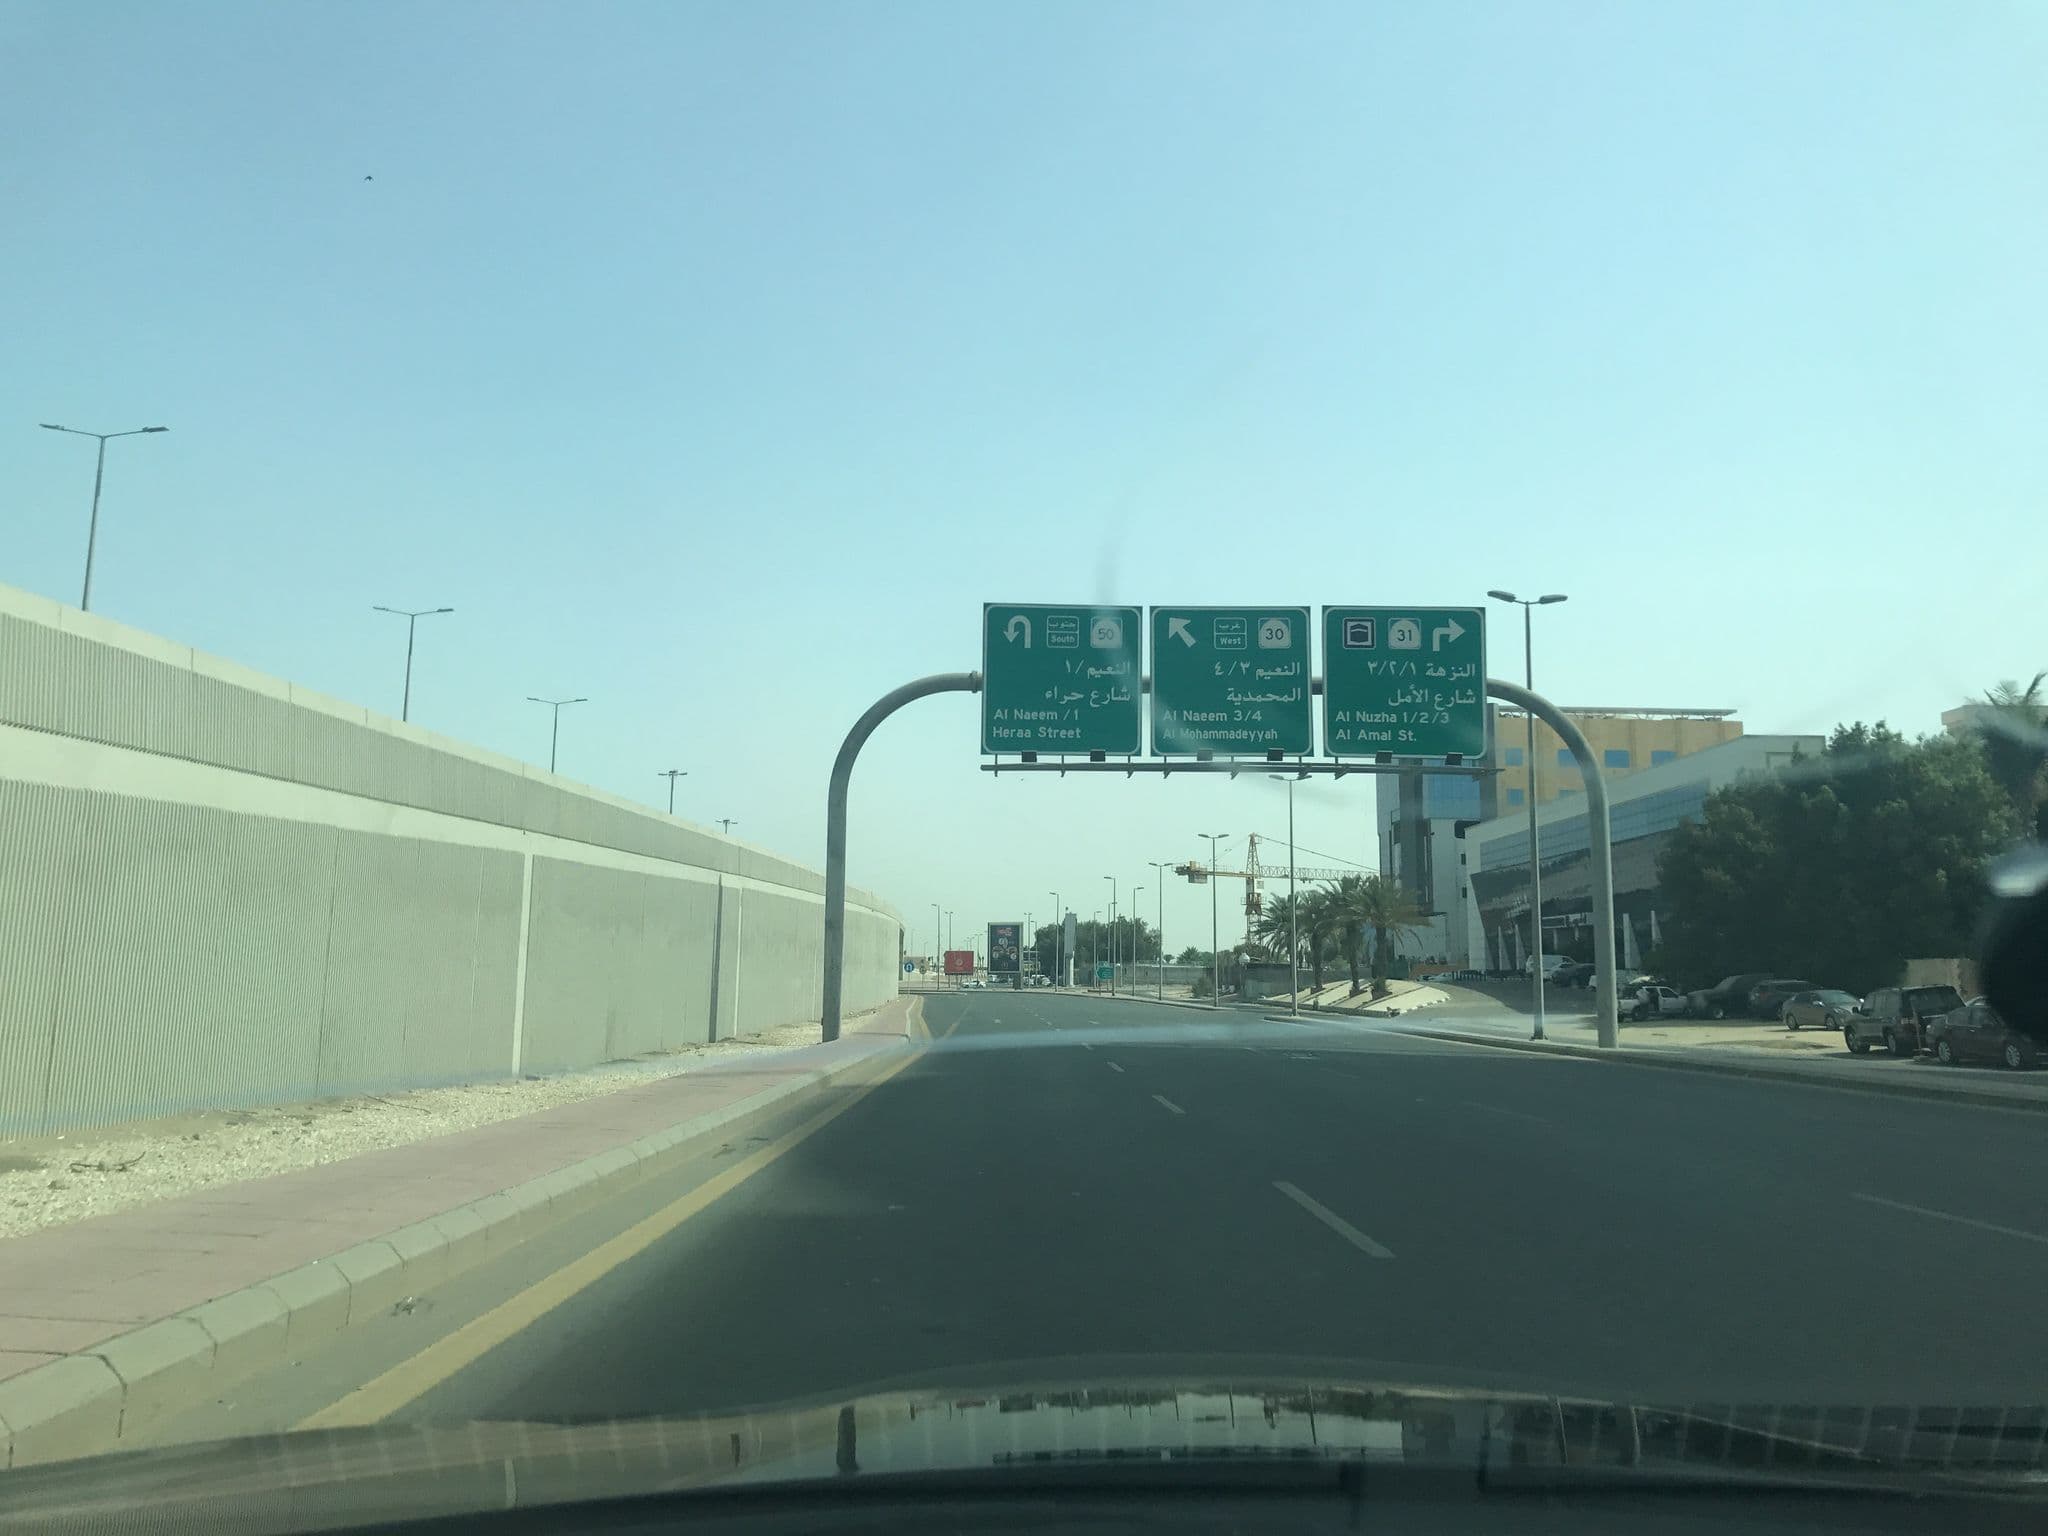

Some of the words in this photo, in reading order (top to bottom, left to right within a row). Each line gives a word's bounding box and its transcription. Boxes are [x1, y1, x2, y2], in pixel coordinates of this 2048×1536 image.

[1098, 628, 1114, 640] 50
[1265, 628, 1284, 640] 30
[1396, 629, 1412, 641] 31
[1220, 636, 1241, 645] West
[1255, 662, 1300, 680] النعيم
[1425, 663, 1476, 681] النزهة
[1045, 686, 1085, 704] حراء
[1089, 687, 1131, 707] شارع
[1226, 687, 1301, 705] المحمدية
[1388, 684, 1428, 706] الأمل
[1434, 689, 1476, 710] شارع
[994, 709, 1008, 720] Al
[1014, 709, 1058, 720] Naeem
[1163, 710, 1177, 721] Al
[1183, 710, 1227, 721] Naeem
[1233, 710, 1262, 721] 3/4
[1336, 712, 1350, 722] Al
[1356, 712, 1397, 723] Nuzha
[993, 727, 1031, 738] Heraa
[1038, 727, 1082, 738] Street
[1163, 728, 1176, 739] Al
[1180, 729, 1278, 742] Mohammadeyyah
[1336, 729, 1350, 740] Al
[1357, 729, 1392, 740] Amal
[1398, 729, 1417, 741] St.
